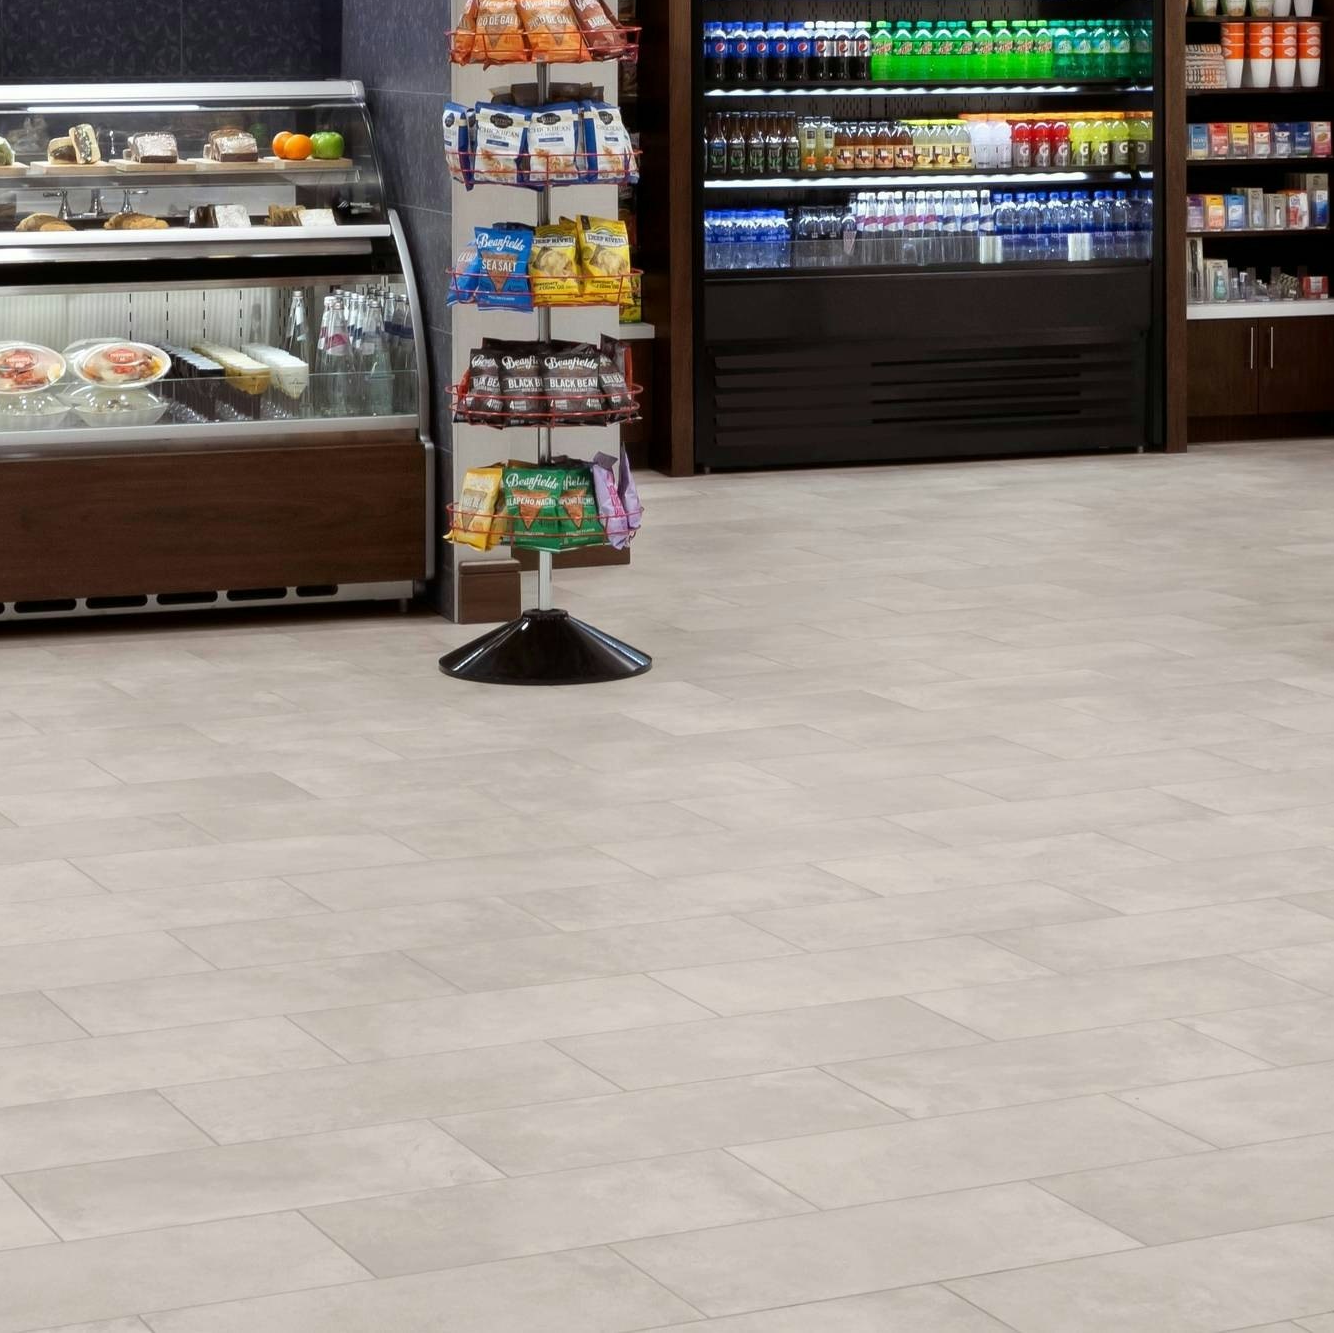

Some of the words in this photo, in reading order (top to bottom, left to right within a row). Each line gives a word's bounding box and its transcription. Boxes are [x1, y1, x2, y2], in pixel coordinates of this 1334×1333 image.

[476, 233, 526, 251] Beanfields
[482, 258, 497, 271] SEA
[498, 260, 517, 273] SALT
[544, 356, 599, 370] Beanfields
[508, 377, 535, 388] BLACK
[549, 378, 576, 388] BLACK
[577, 377, 598, 388] BEAN
[509, 400, 515, 410] 4
[505, 473, 559, 491] Beanfields
